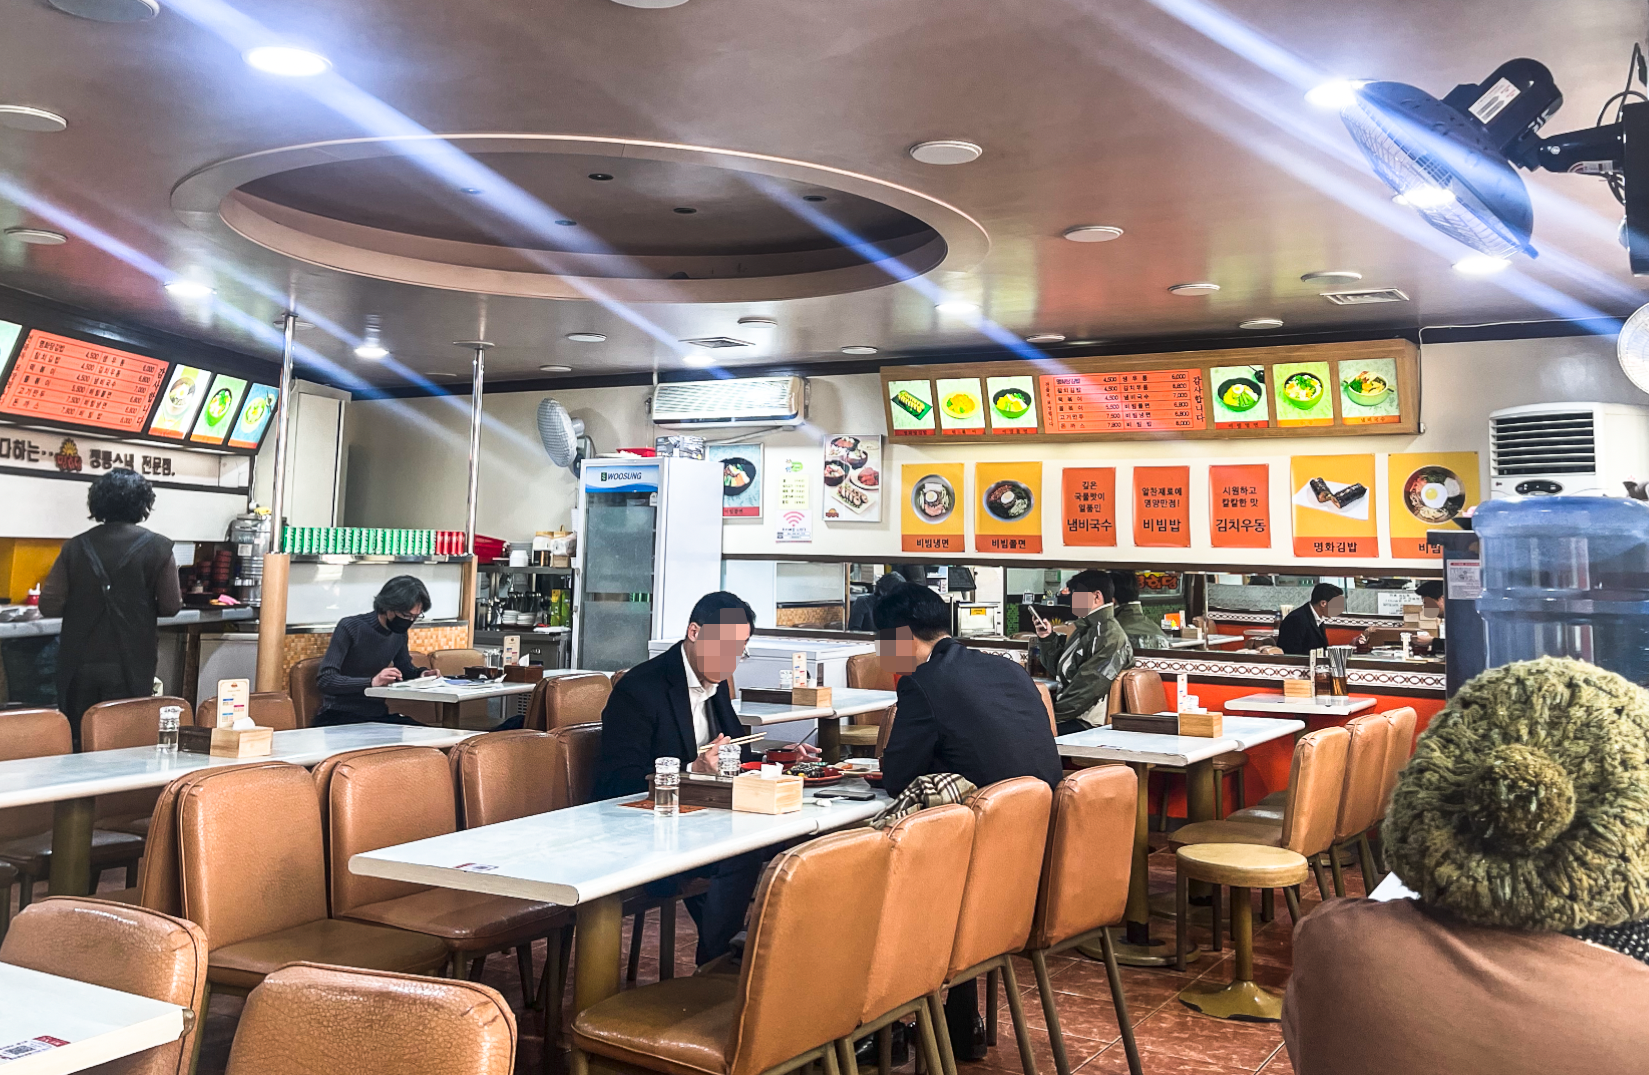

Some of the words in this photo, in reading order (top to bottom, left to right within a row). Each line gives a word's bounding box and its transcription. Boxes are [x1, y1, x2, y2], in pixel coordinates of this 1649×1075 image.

[136, 367, 166, 427] 감사합니다
[1193, 375, 1206, 422] 감사합니다
[607, 472, 641, 480] WOOSUNG
[1082, 481, 1097, 490] 깊은
[1222, 486, 1257, 495] 시원하고
[1075, 492, 1105, 501] 국물맛이
[1078, 503, 1101, 513] 일품인
[1144, 499, 1180, 508] 영양만점!
[1222, 498, 1247, 508] 칼칼한
[1250, 498, 1258, 508] 맛
[1067, 519, 1112, 532] 냄비국수
[1143, 519, 1181, 532] 비빔밥
[1216, 519, 1266, 533] 김치우동
[916, 538, 949, 548] 비빔냉면
[991, 539, 1026, 549] 비빔쫄면
[1313, 541, 1357, 553] 명화김밥
